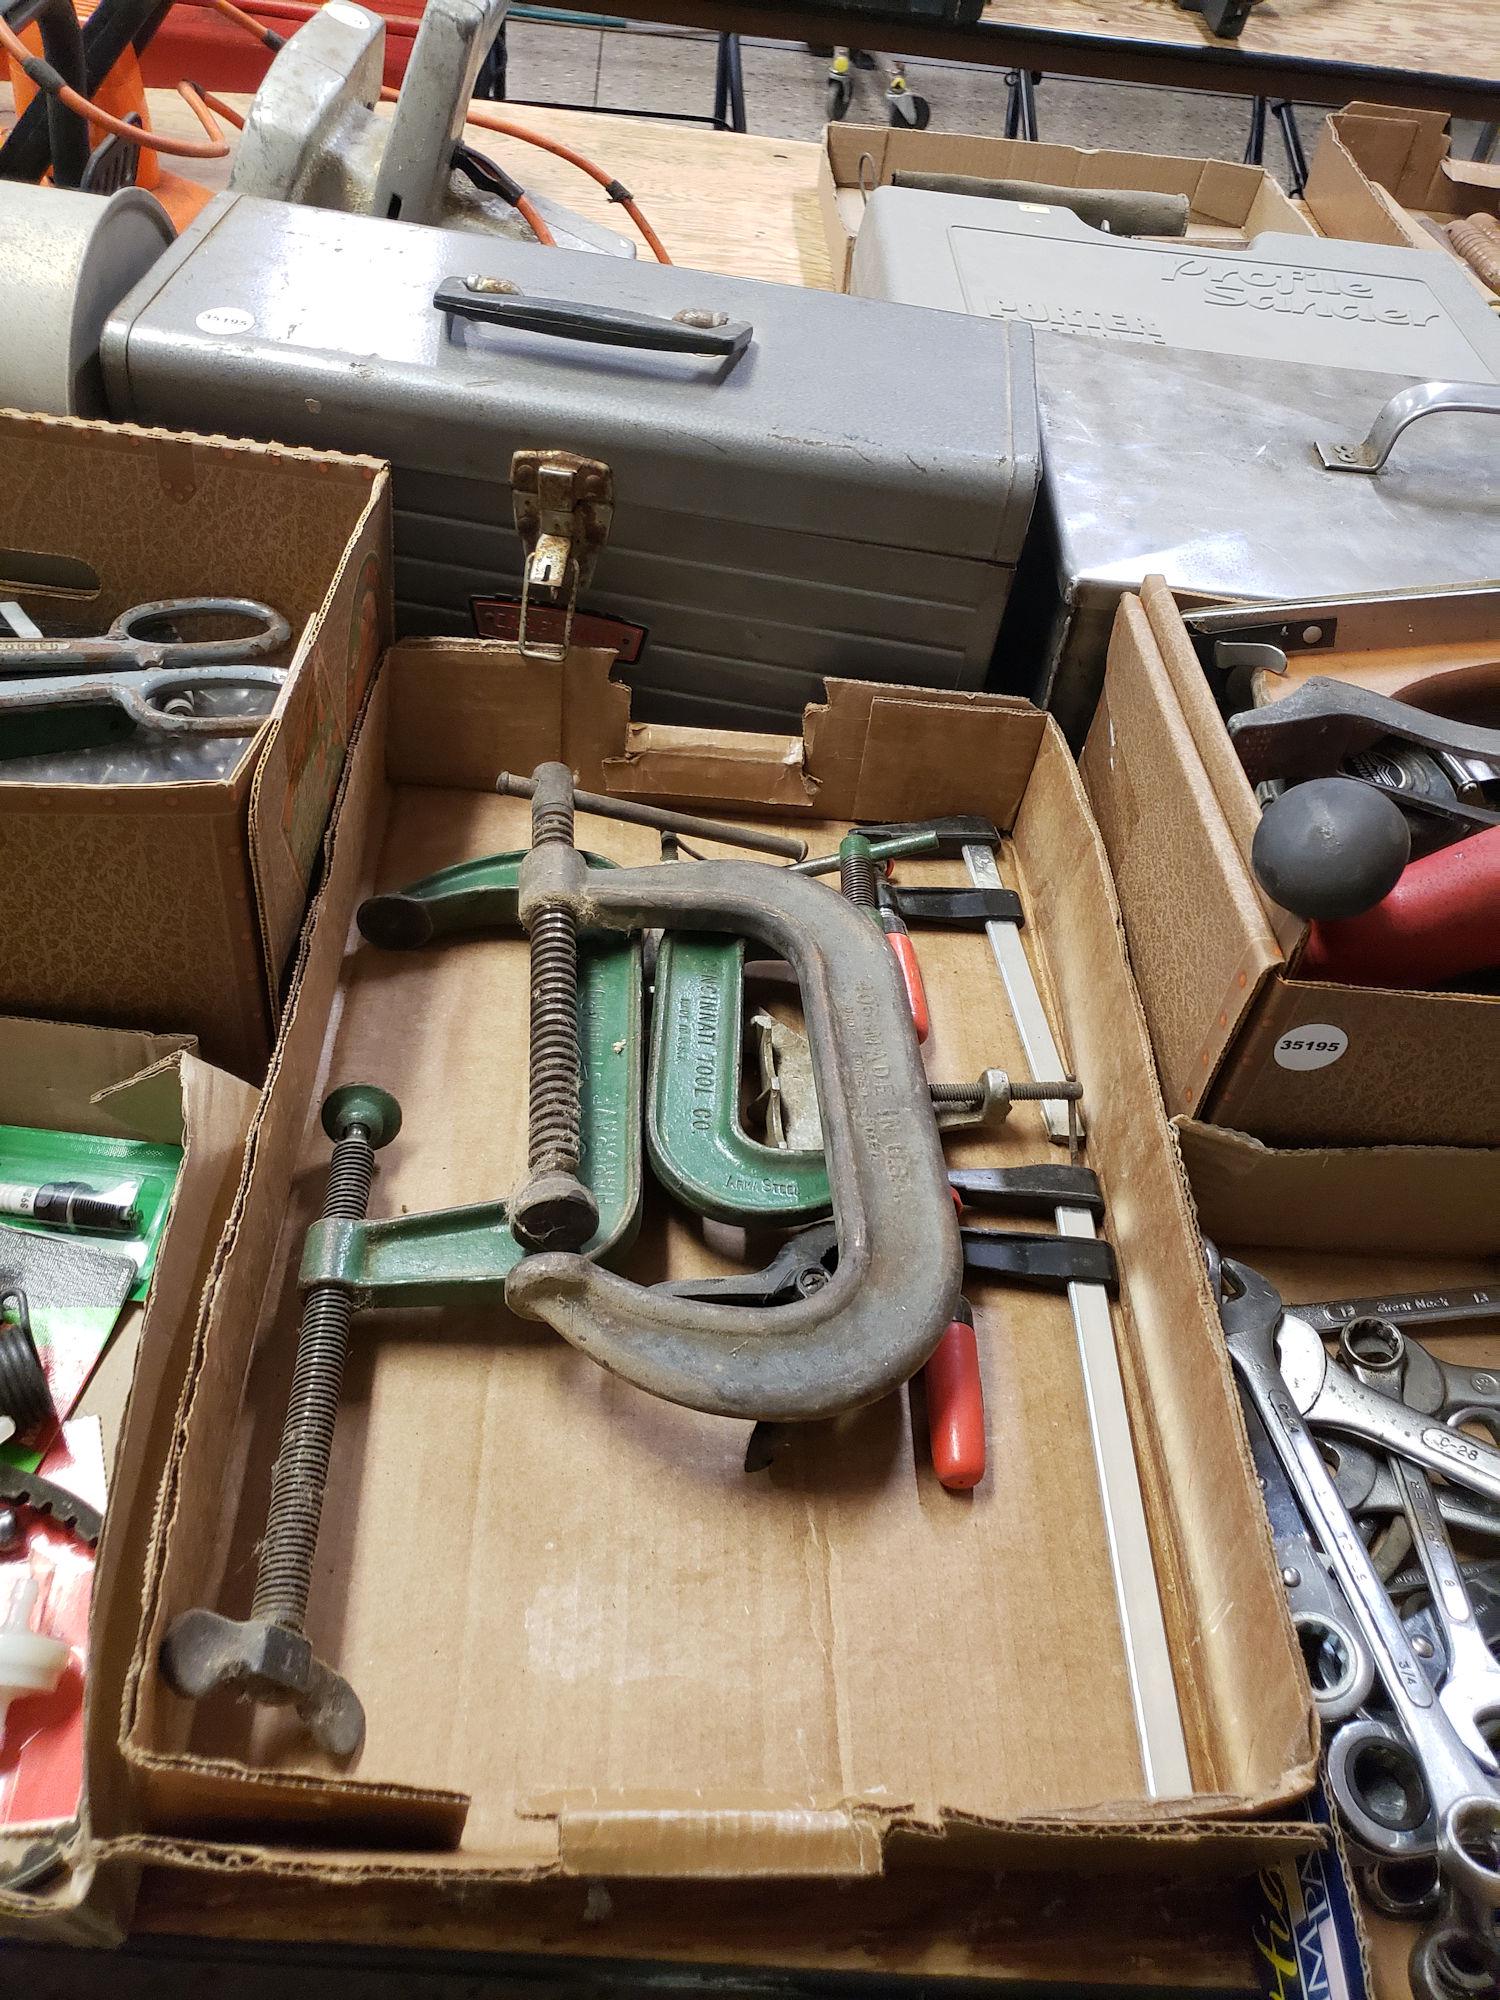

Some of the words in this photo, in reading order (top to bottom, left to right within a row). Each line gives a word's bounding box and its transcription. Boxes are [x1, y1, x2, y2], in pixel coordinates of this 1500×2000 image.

[986, 293, 1163, 338] PORTER
[1204, 282, 1440, 327] Sander
[0, 641, 60, 652] ORGED
[1280, 1040, 1340, 1052] 35195
[694, 1055, 715, 1098] TOOL
[692, 1107, 712, 1135] CO.
[1440, 1437, 1479, 1461] C-28
[1399, 1660, 1417, 1685] 3/4
